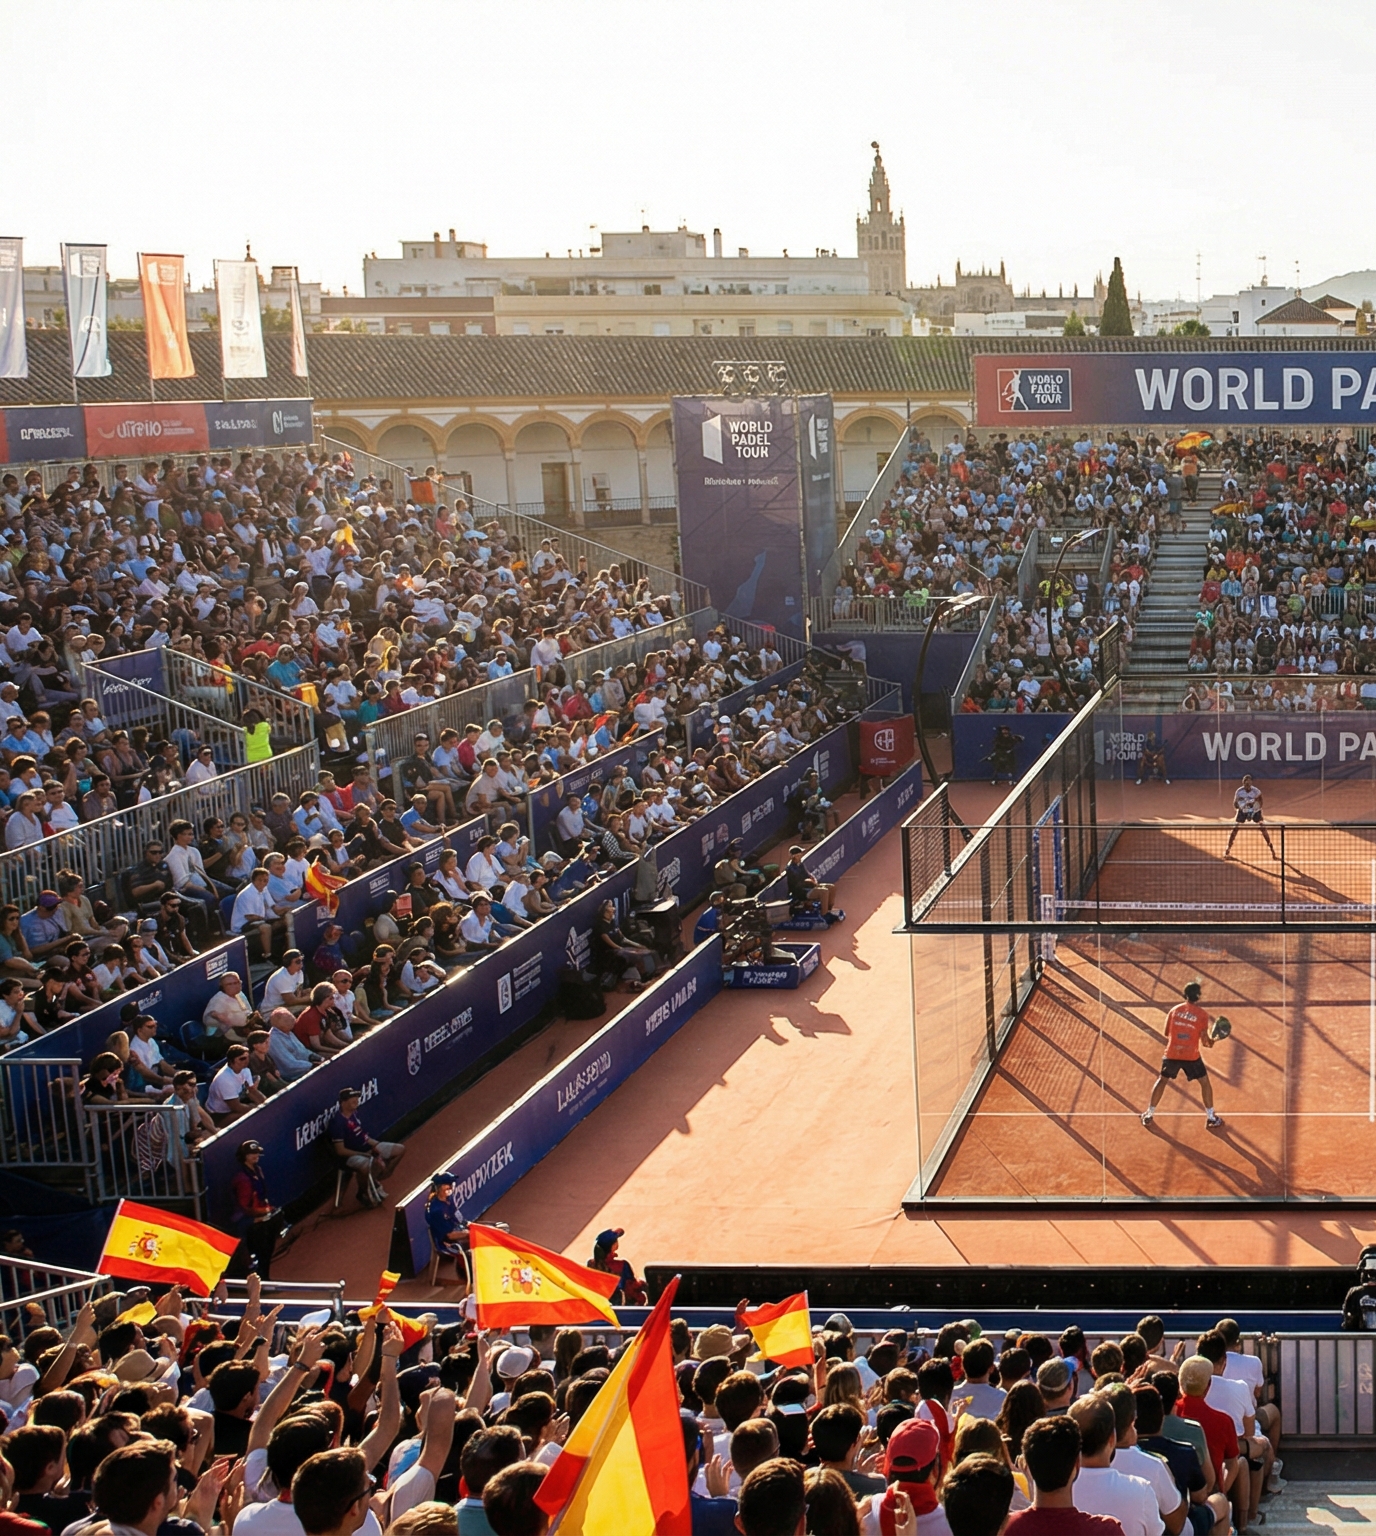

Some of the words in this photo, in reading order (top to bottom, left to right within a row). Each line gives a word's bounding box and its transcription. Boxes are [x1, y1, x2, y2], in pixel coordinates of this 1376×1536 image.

[1134, 366, 1314, 411] WORLD
[729, 421, 773, 433] WORLD
[731, 433, 771, 445] PADEL
[735, 446, 769, 458] TOUR
[1202, 731, 1327, 761] WORLD
